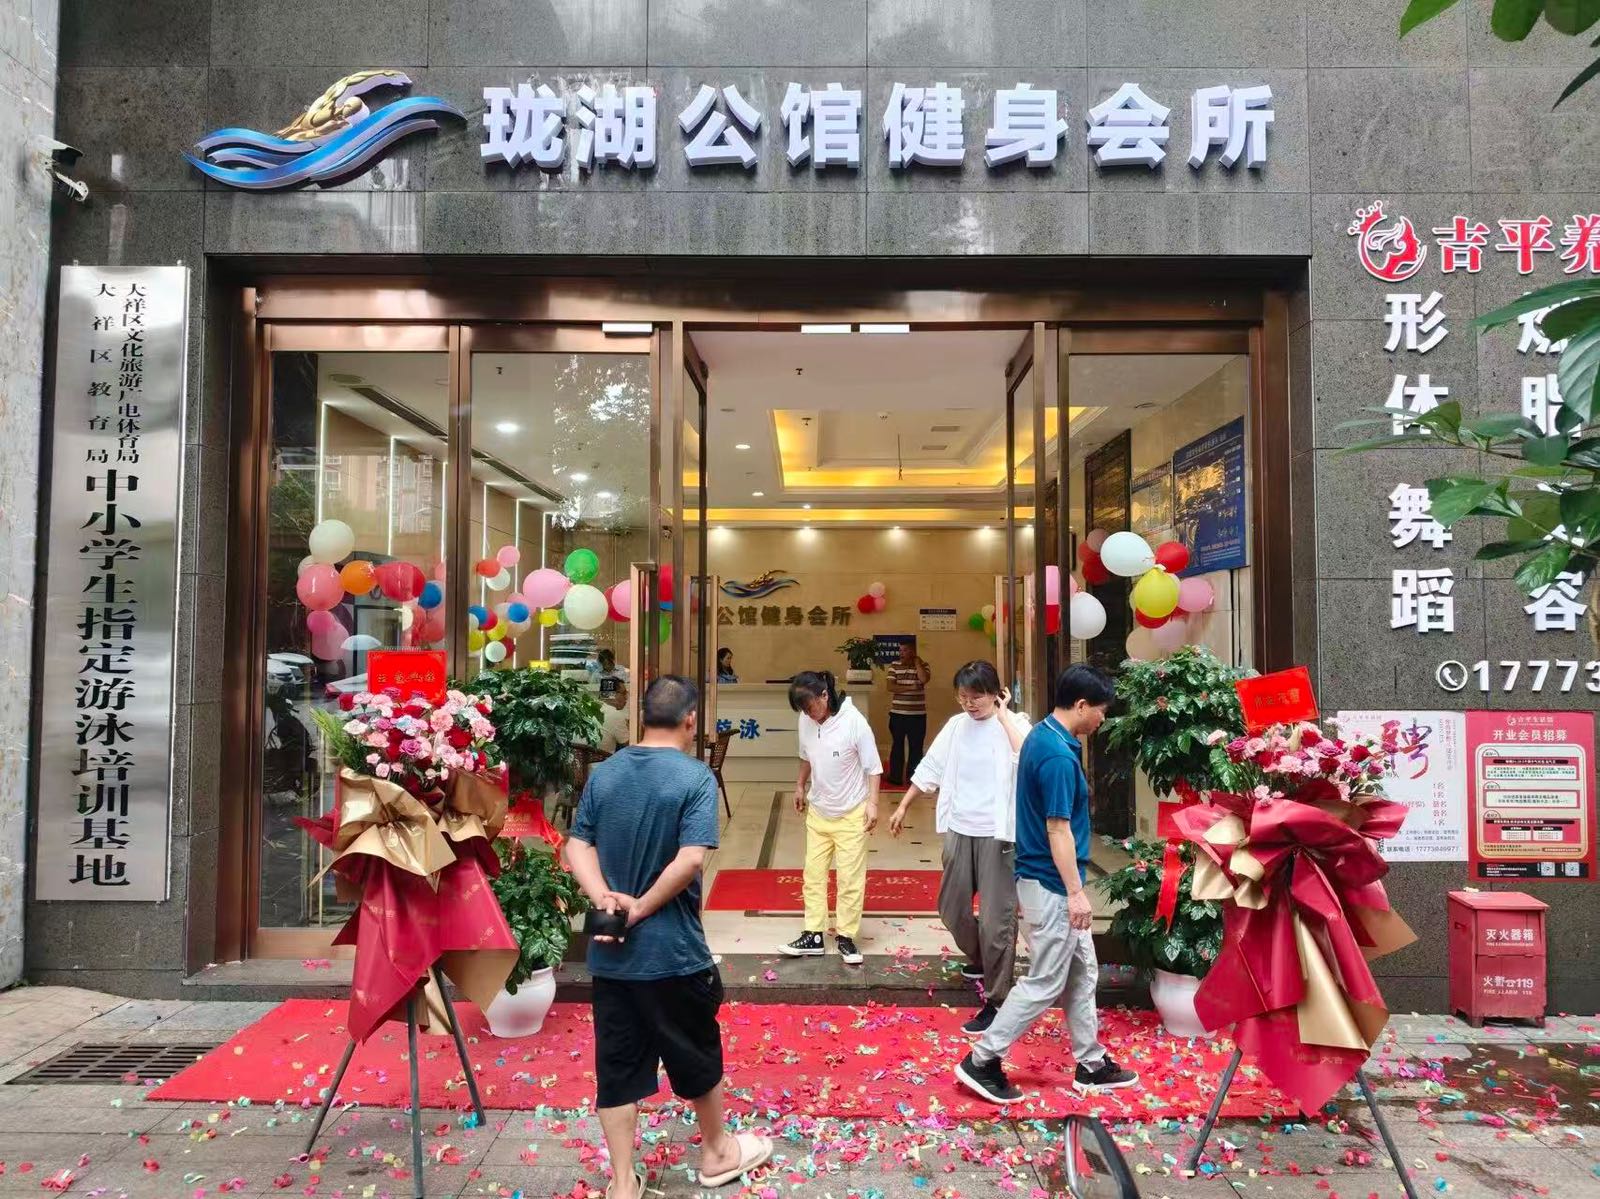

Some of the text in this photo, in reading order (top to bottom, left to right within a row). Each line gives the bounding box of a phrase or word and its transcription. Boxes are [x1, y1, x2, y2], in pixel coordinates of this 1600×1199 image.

[480, 81, 1275, 172] 珑湖公馆健身会所
[86, 283, 116, 464] 大祥区教育局
[116, 283, 147, 464] 大祥区文化旅游广电体育局
[67, 468, 142, 888] 中小学生指定游泳培训基地
[1473, 660, 1600, 692] 17773
[1493, 729, 1568, 741] 开业会员招募
[1485, 928, 1535, 941] 灭火器箱
